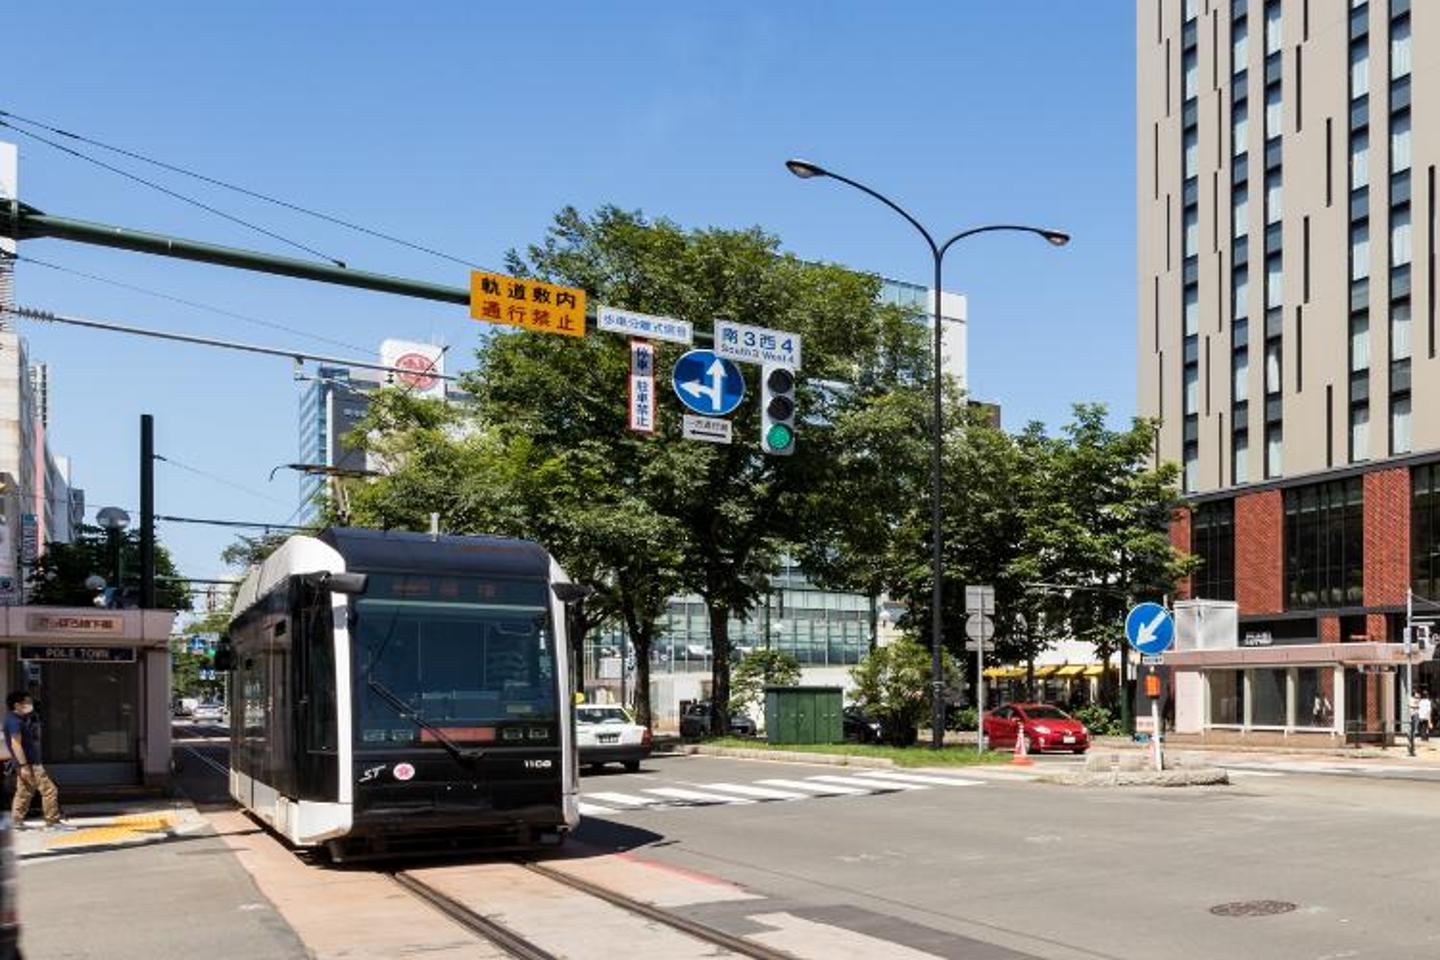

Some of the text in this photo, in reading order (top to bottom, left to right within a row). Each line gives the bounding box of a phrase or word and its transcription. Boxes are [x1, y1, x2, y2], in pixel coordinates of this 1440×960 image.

[481, 277, 576, 309] 軌道敷内
[481, 300, 577, 330] 通行禁止
[722, 328, 794, 354] 南3西4
[45, 648, 75, 658] POLE
